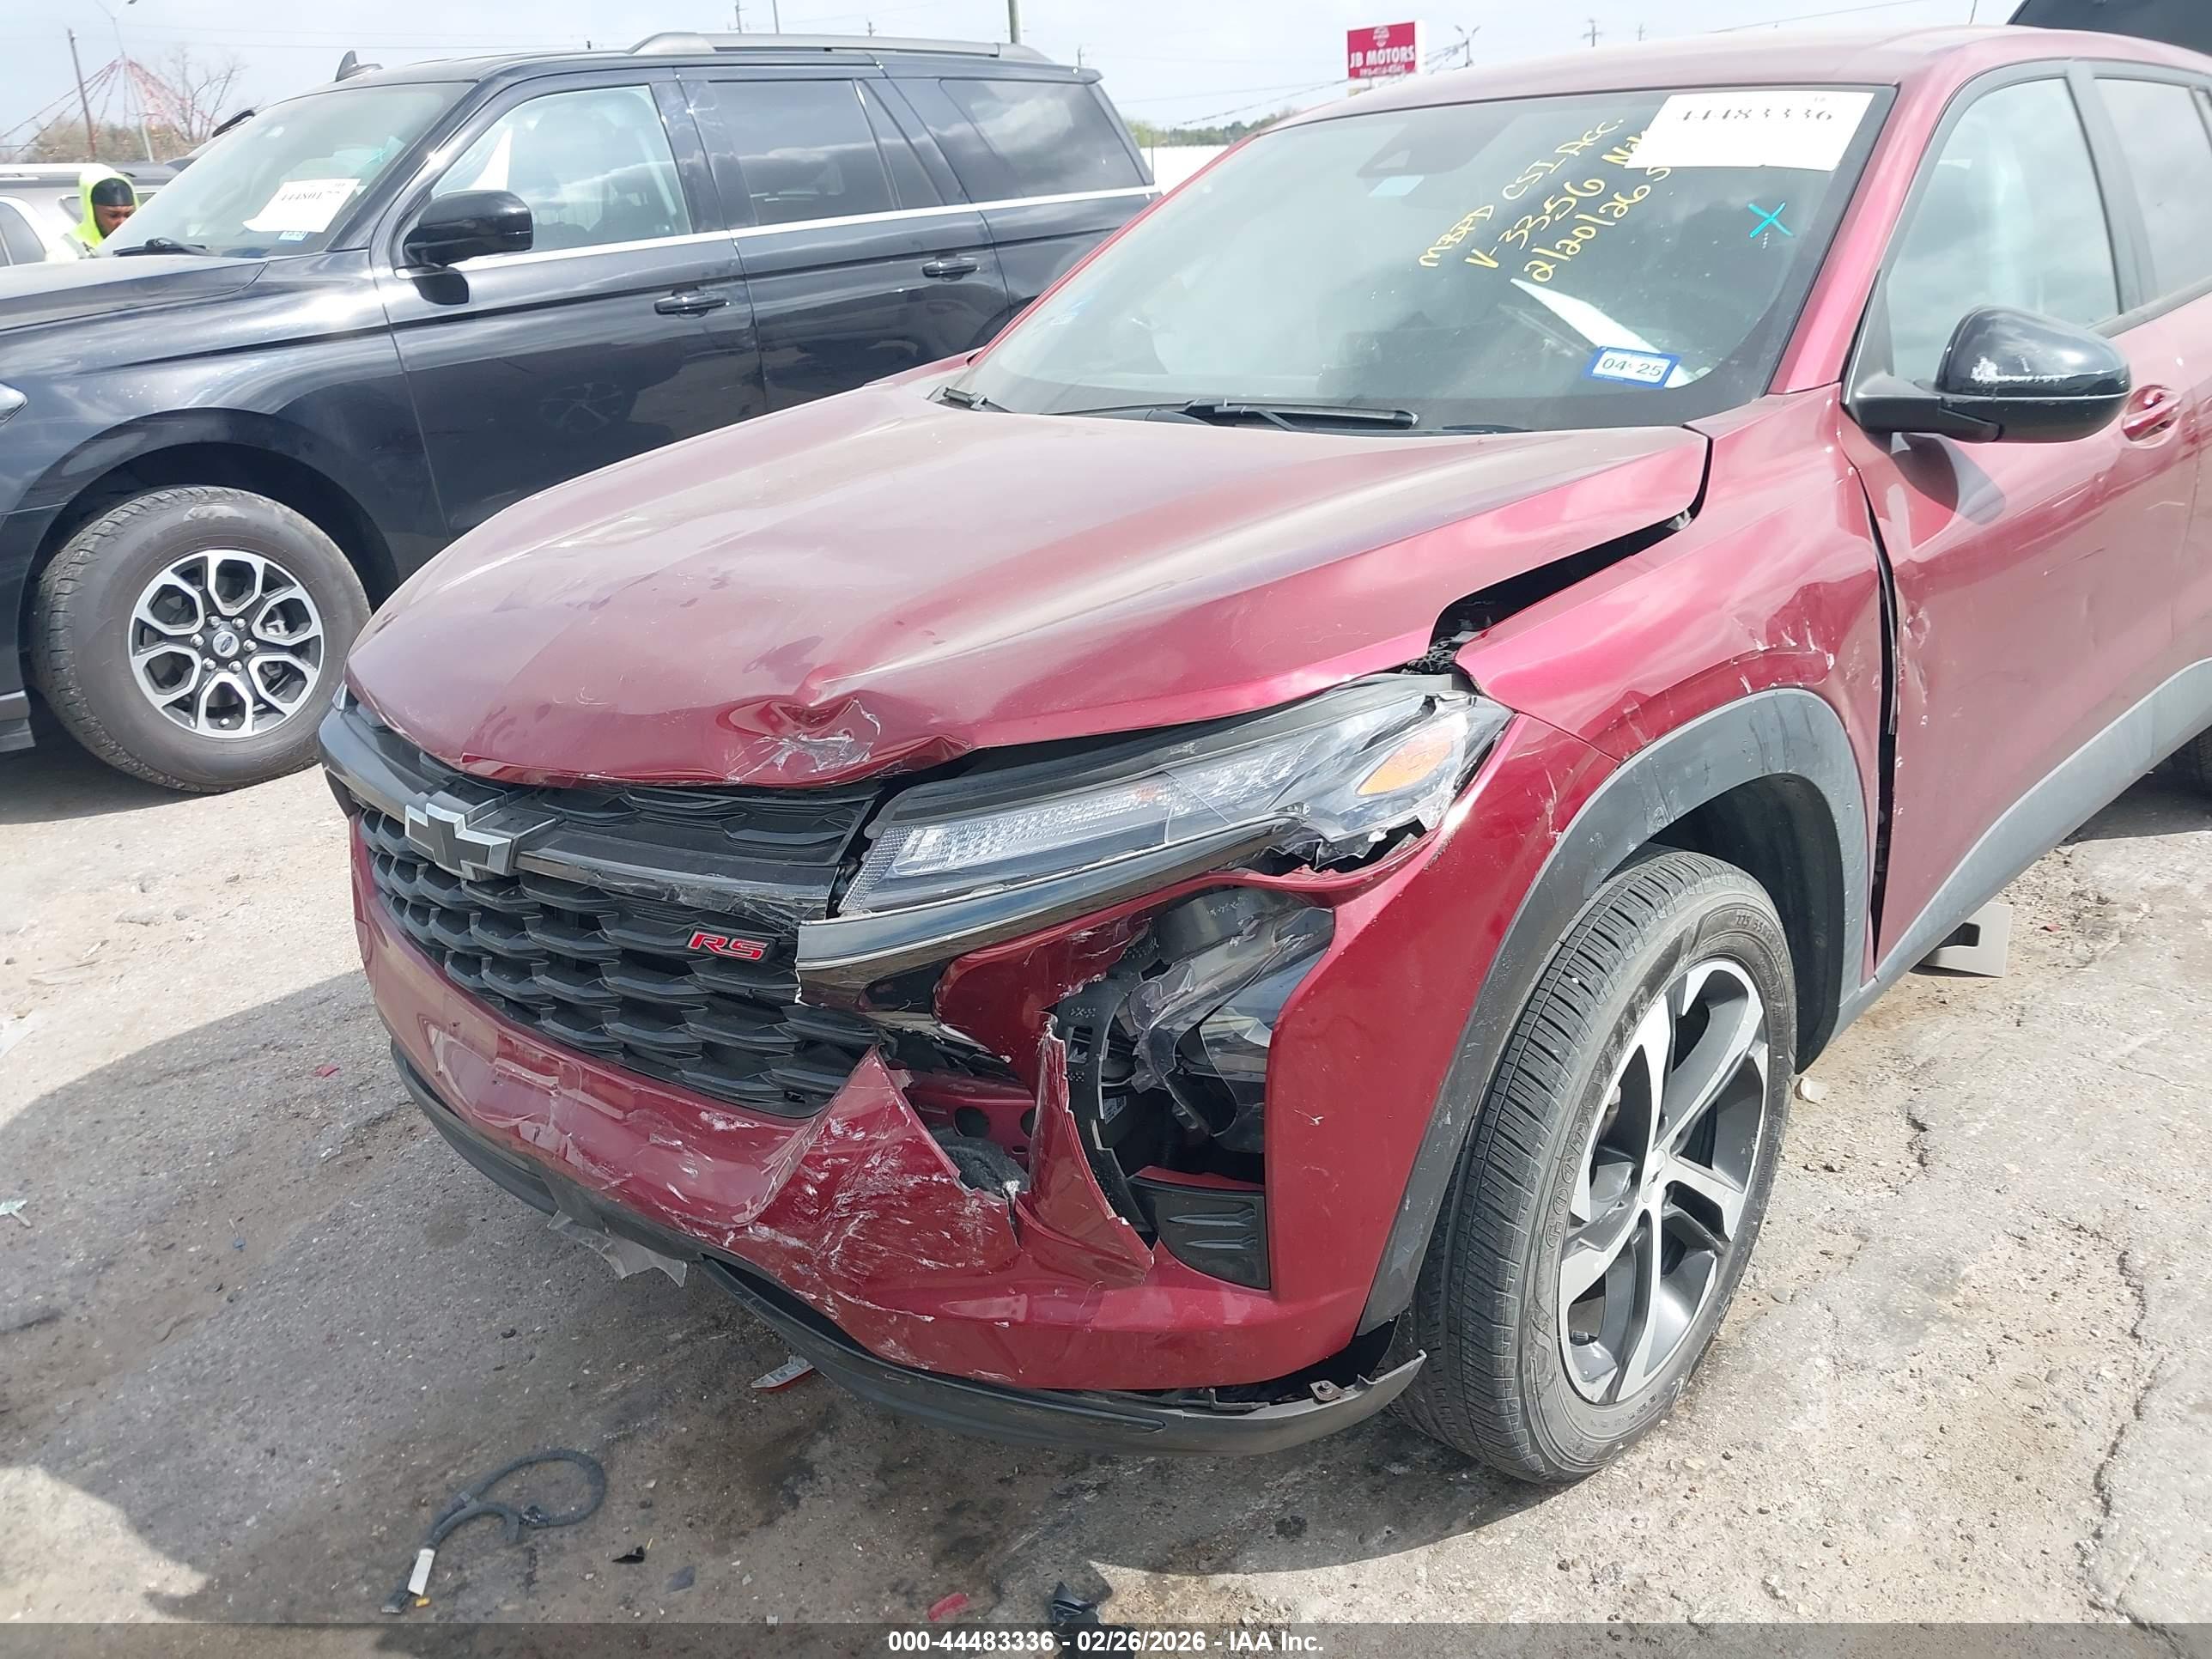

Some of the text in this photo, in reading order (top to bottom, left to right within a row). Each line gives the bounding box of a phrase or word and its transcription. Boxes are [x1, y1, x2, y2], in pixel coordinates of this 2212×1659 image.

[1350, 45, 1415, 69] JB MOTORS
[1602, 357, 1664, 377] 04 25
[688, 930, 769, 961] RS
